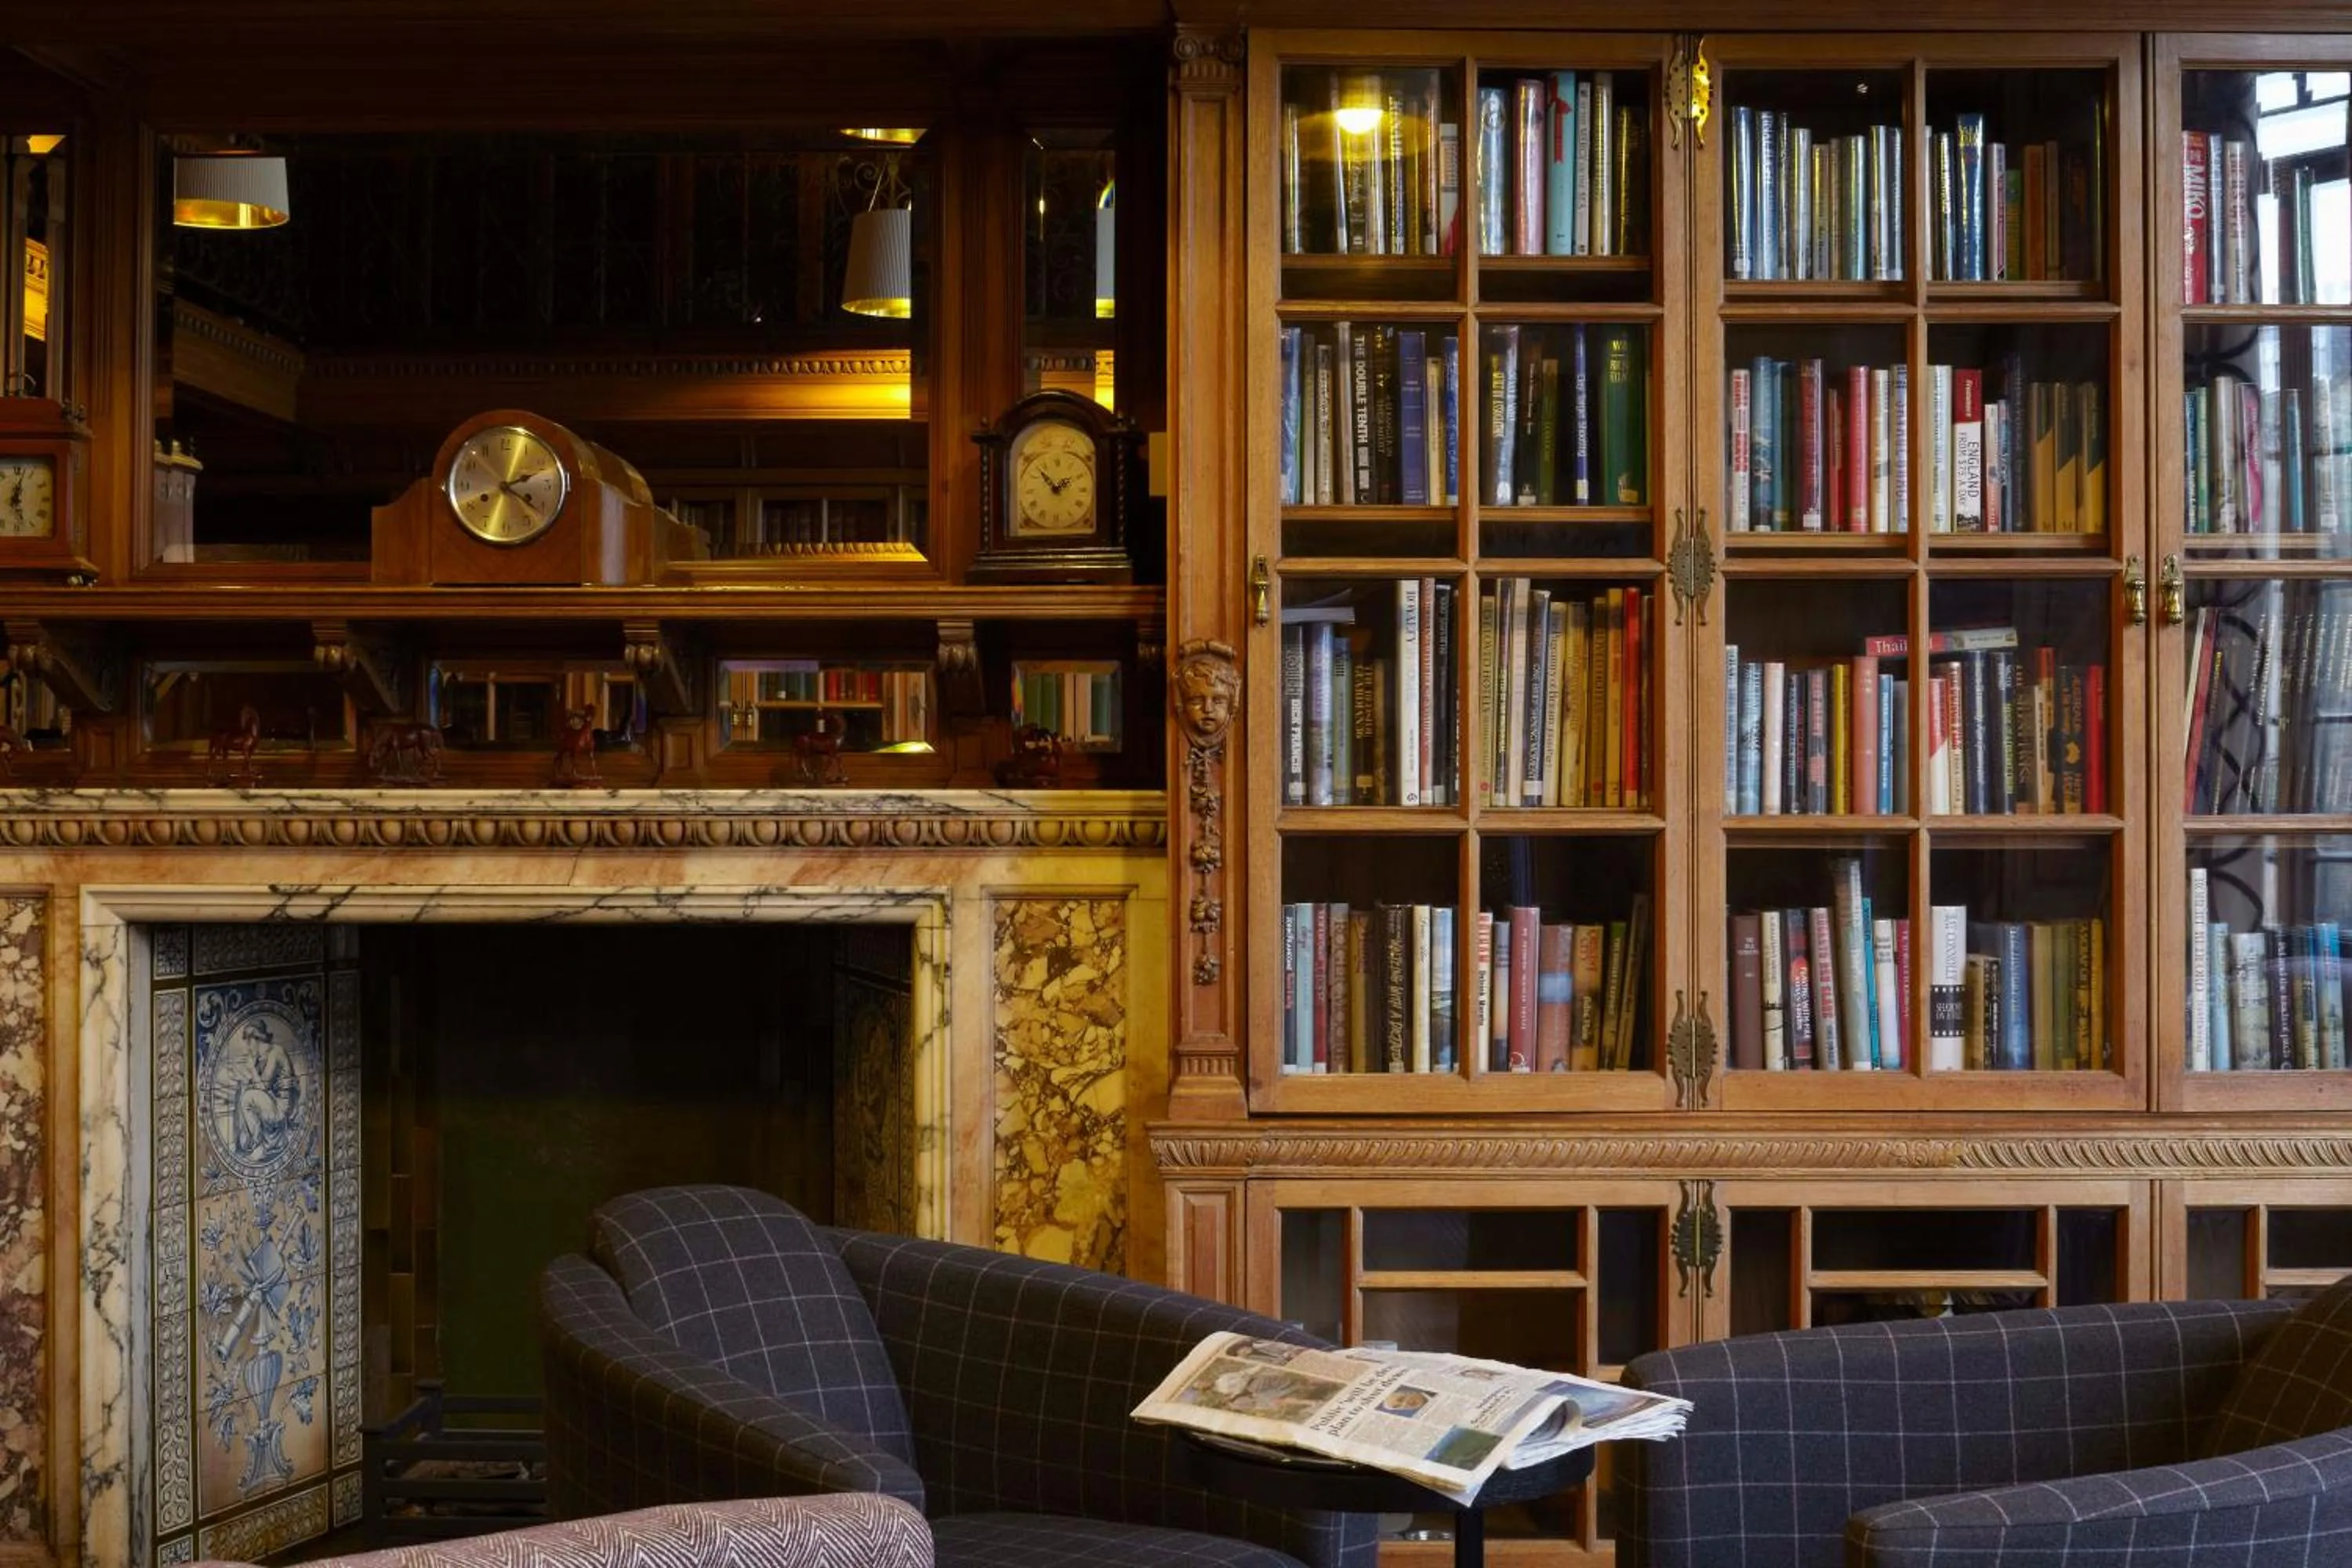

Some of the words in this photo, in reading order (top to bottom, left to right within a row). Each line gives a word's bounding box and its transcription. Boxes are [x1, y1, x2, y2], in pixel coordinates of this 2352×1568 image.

[2184, 165, 2205, 219] MIKO
[1356, 336, 1365, 358] THE
[1356, 361, 1367, 405] DOUBLE
[1358, 407, 1368, 443] TENTH
[1577, 421, 1587, 457] Shooting
[1958, 432, 1967, 456] FROM
[1967, 441, 1979, 497] ENGLAND
[1404, 590, 1417, 643] ROYALTY
[1291, 699, 1301, 727] DICK
[1291, 728, 1301, 773] FRANCIS
[1309, 1406, 1345, 1430] Public
[1327, 1417, 1353, 1437] plan
